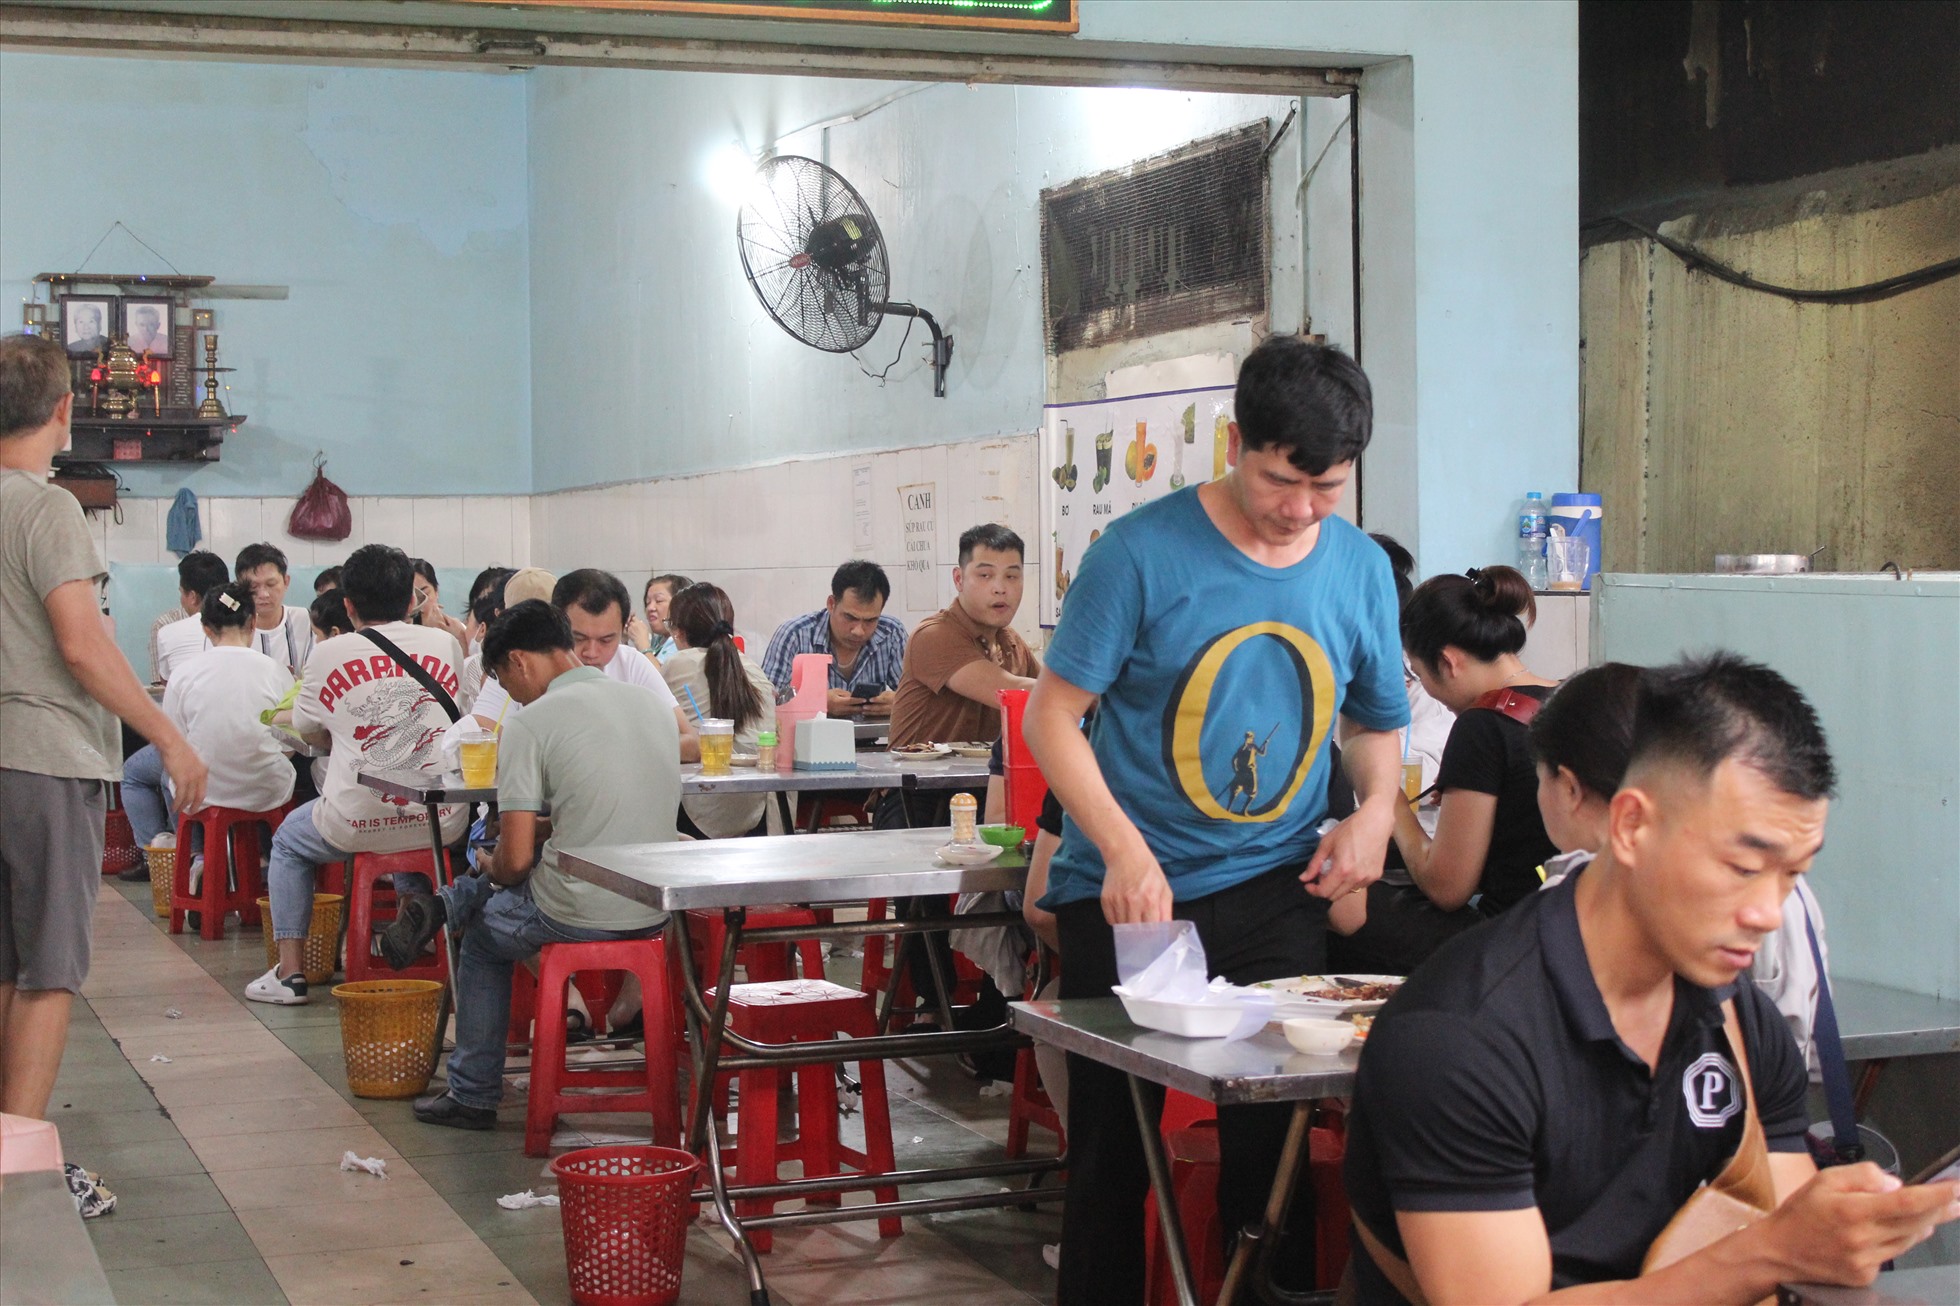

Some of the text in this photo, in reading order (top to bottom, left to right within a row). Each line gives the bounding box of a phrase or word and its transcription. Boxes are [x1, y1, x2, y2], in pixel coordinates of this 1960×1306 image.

[908, 492, 931, 510] CANH
[1093, 503, 1103, 515] RAU
[369, 818, 380, 828] IS
[1699, 1071, 1726, 1110] P
